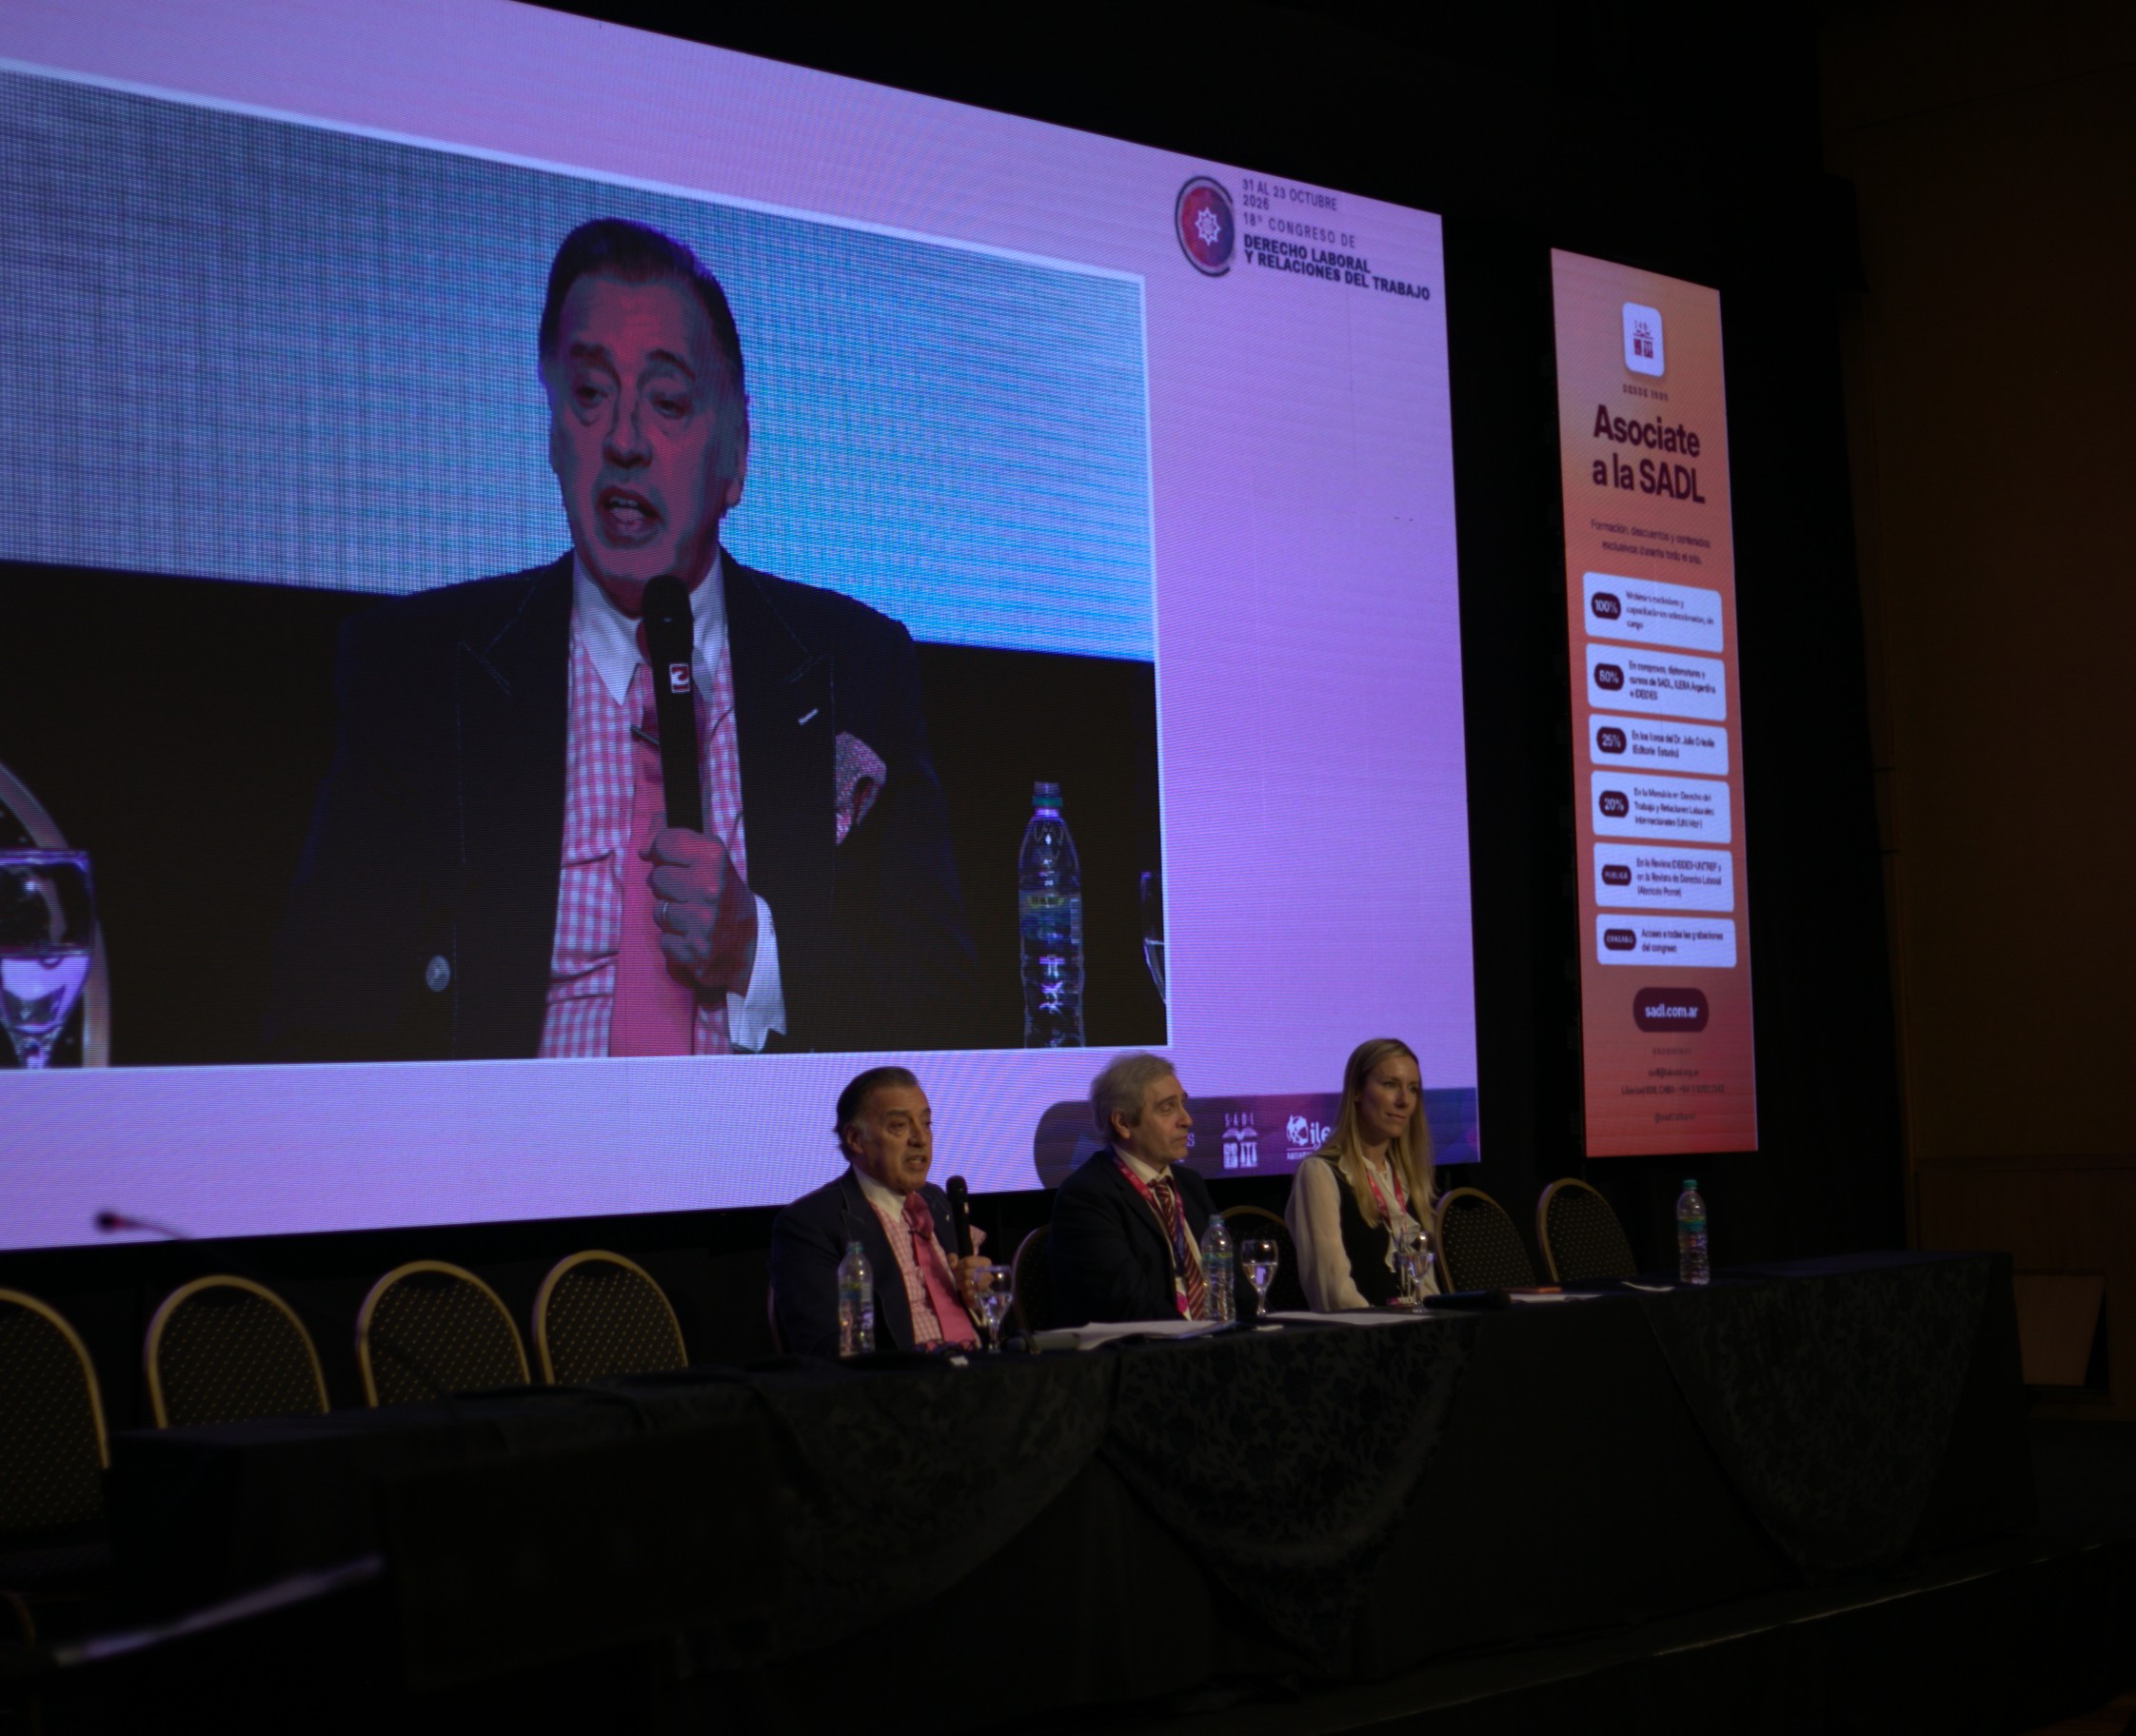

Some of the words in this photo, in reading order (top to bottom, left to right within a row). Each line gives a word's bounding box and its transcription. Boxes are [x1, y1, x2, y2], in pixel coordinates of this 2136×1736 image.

[1243, 178, 1255, 192] 31
[1257, 181, 1270, 196] AL
[1274, 186, 1286, 200] 23
[1289, 188, 1337, 211] OCTUBRE
[1243, 194, 1270, 210] 2026
[1269, 217, 1335, 244] CONGRESO
[1340, 232, 1355, 248] DE
[1244, 234, 1308, 260] DERECHO
[1312, 248, 1371, 274] LABORAL
[1244, 249, 1255, 265] Y
[1257, 252, 1341, 283] RELACIONES
[1345, 270, 1370, 288] DEL
[1372, 276, 1431, 301] TRABAJO
[1593, 404, 1700, 458] Asociate
[1592, 460, 1607, 486] a
[1612, 452, 1634, 491] la
[1639, 459, 1706, 504] SADL
[1594, 599, 1618, 614] 100%
[1599, 669, 1620, 684] 50%
[1601, 732, 1622, 748] 25%
[1604, 798, 1625, 813] 20%
[1645, 1002, 1699, 1018] sadl.com.ar
